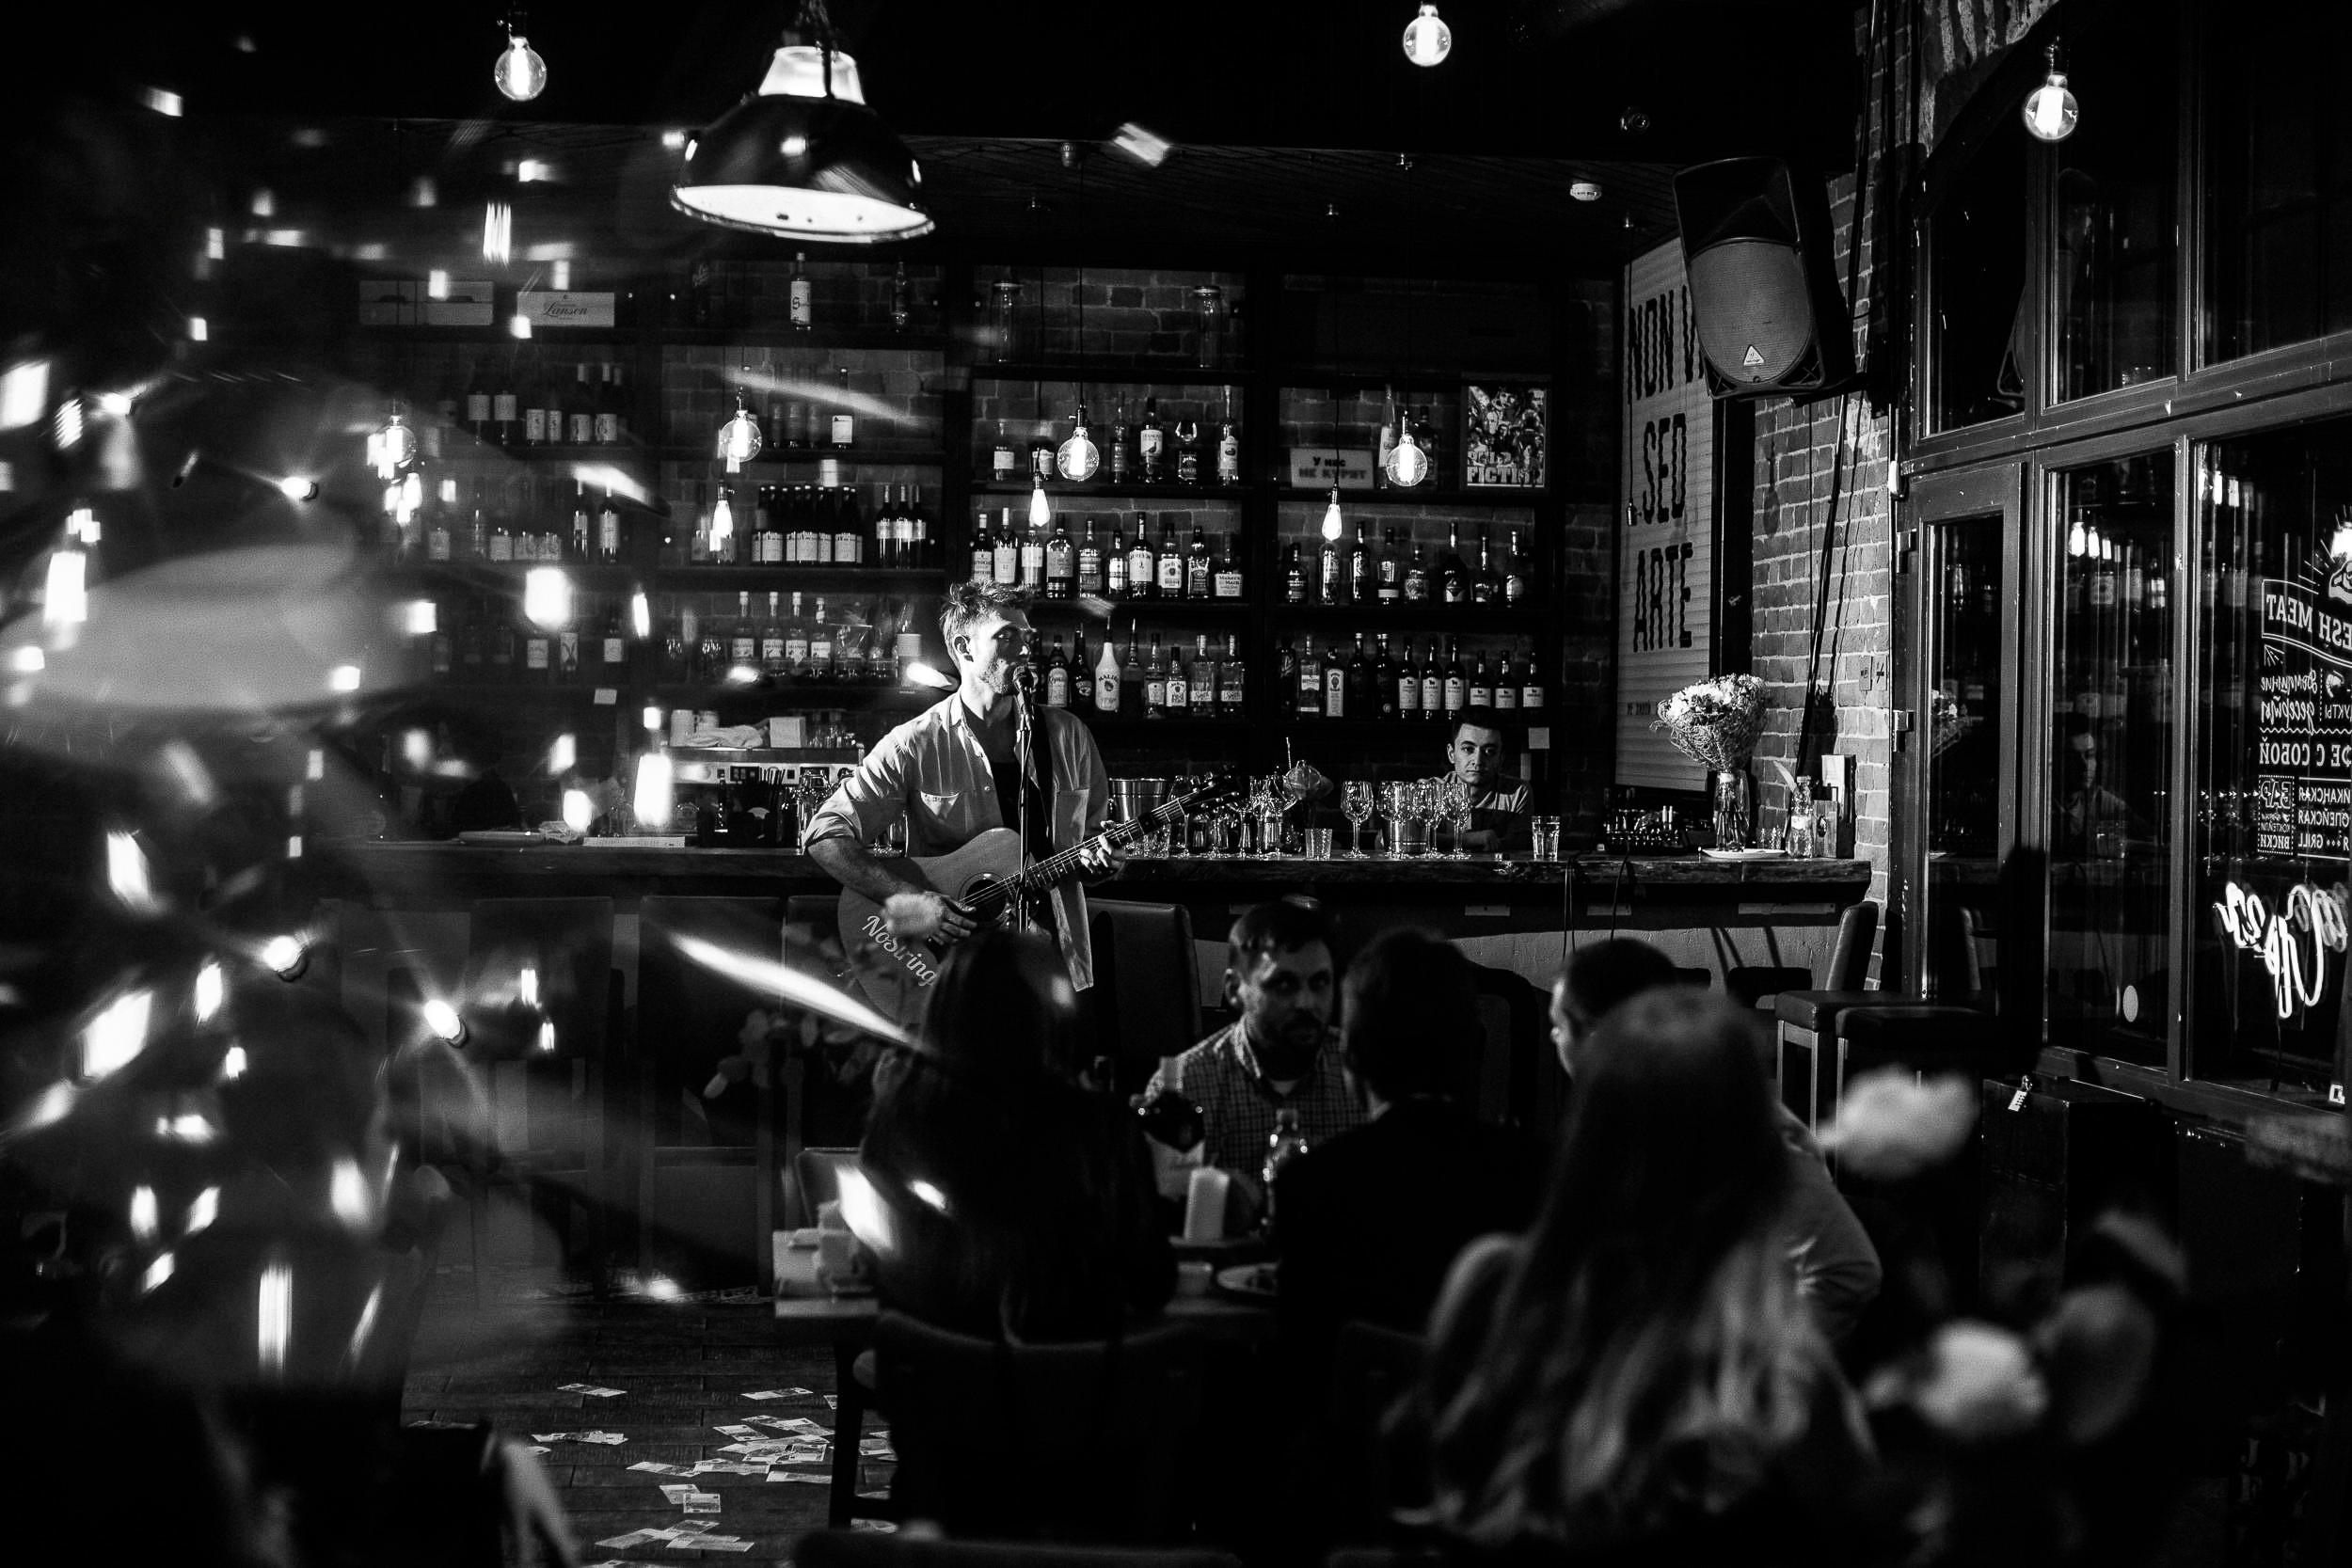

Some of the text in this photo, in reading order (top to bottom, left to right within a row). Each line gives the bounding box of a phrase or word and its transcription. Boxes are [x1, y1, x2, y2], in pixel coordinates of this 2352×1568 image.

[1627, 290, 1674, 404] NON
[1643, 412, 1687, 525] SED
[1633, 541, 1693, 652] ARTE
